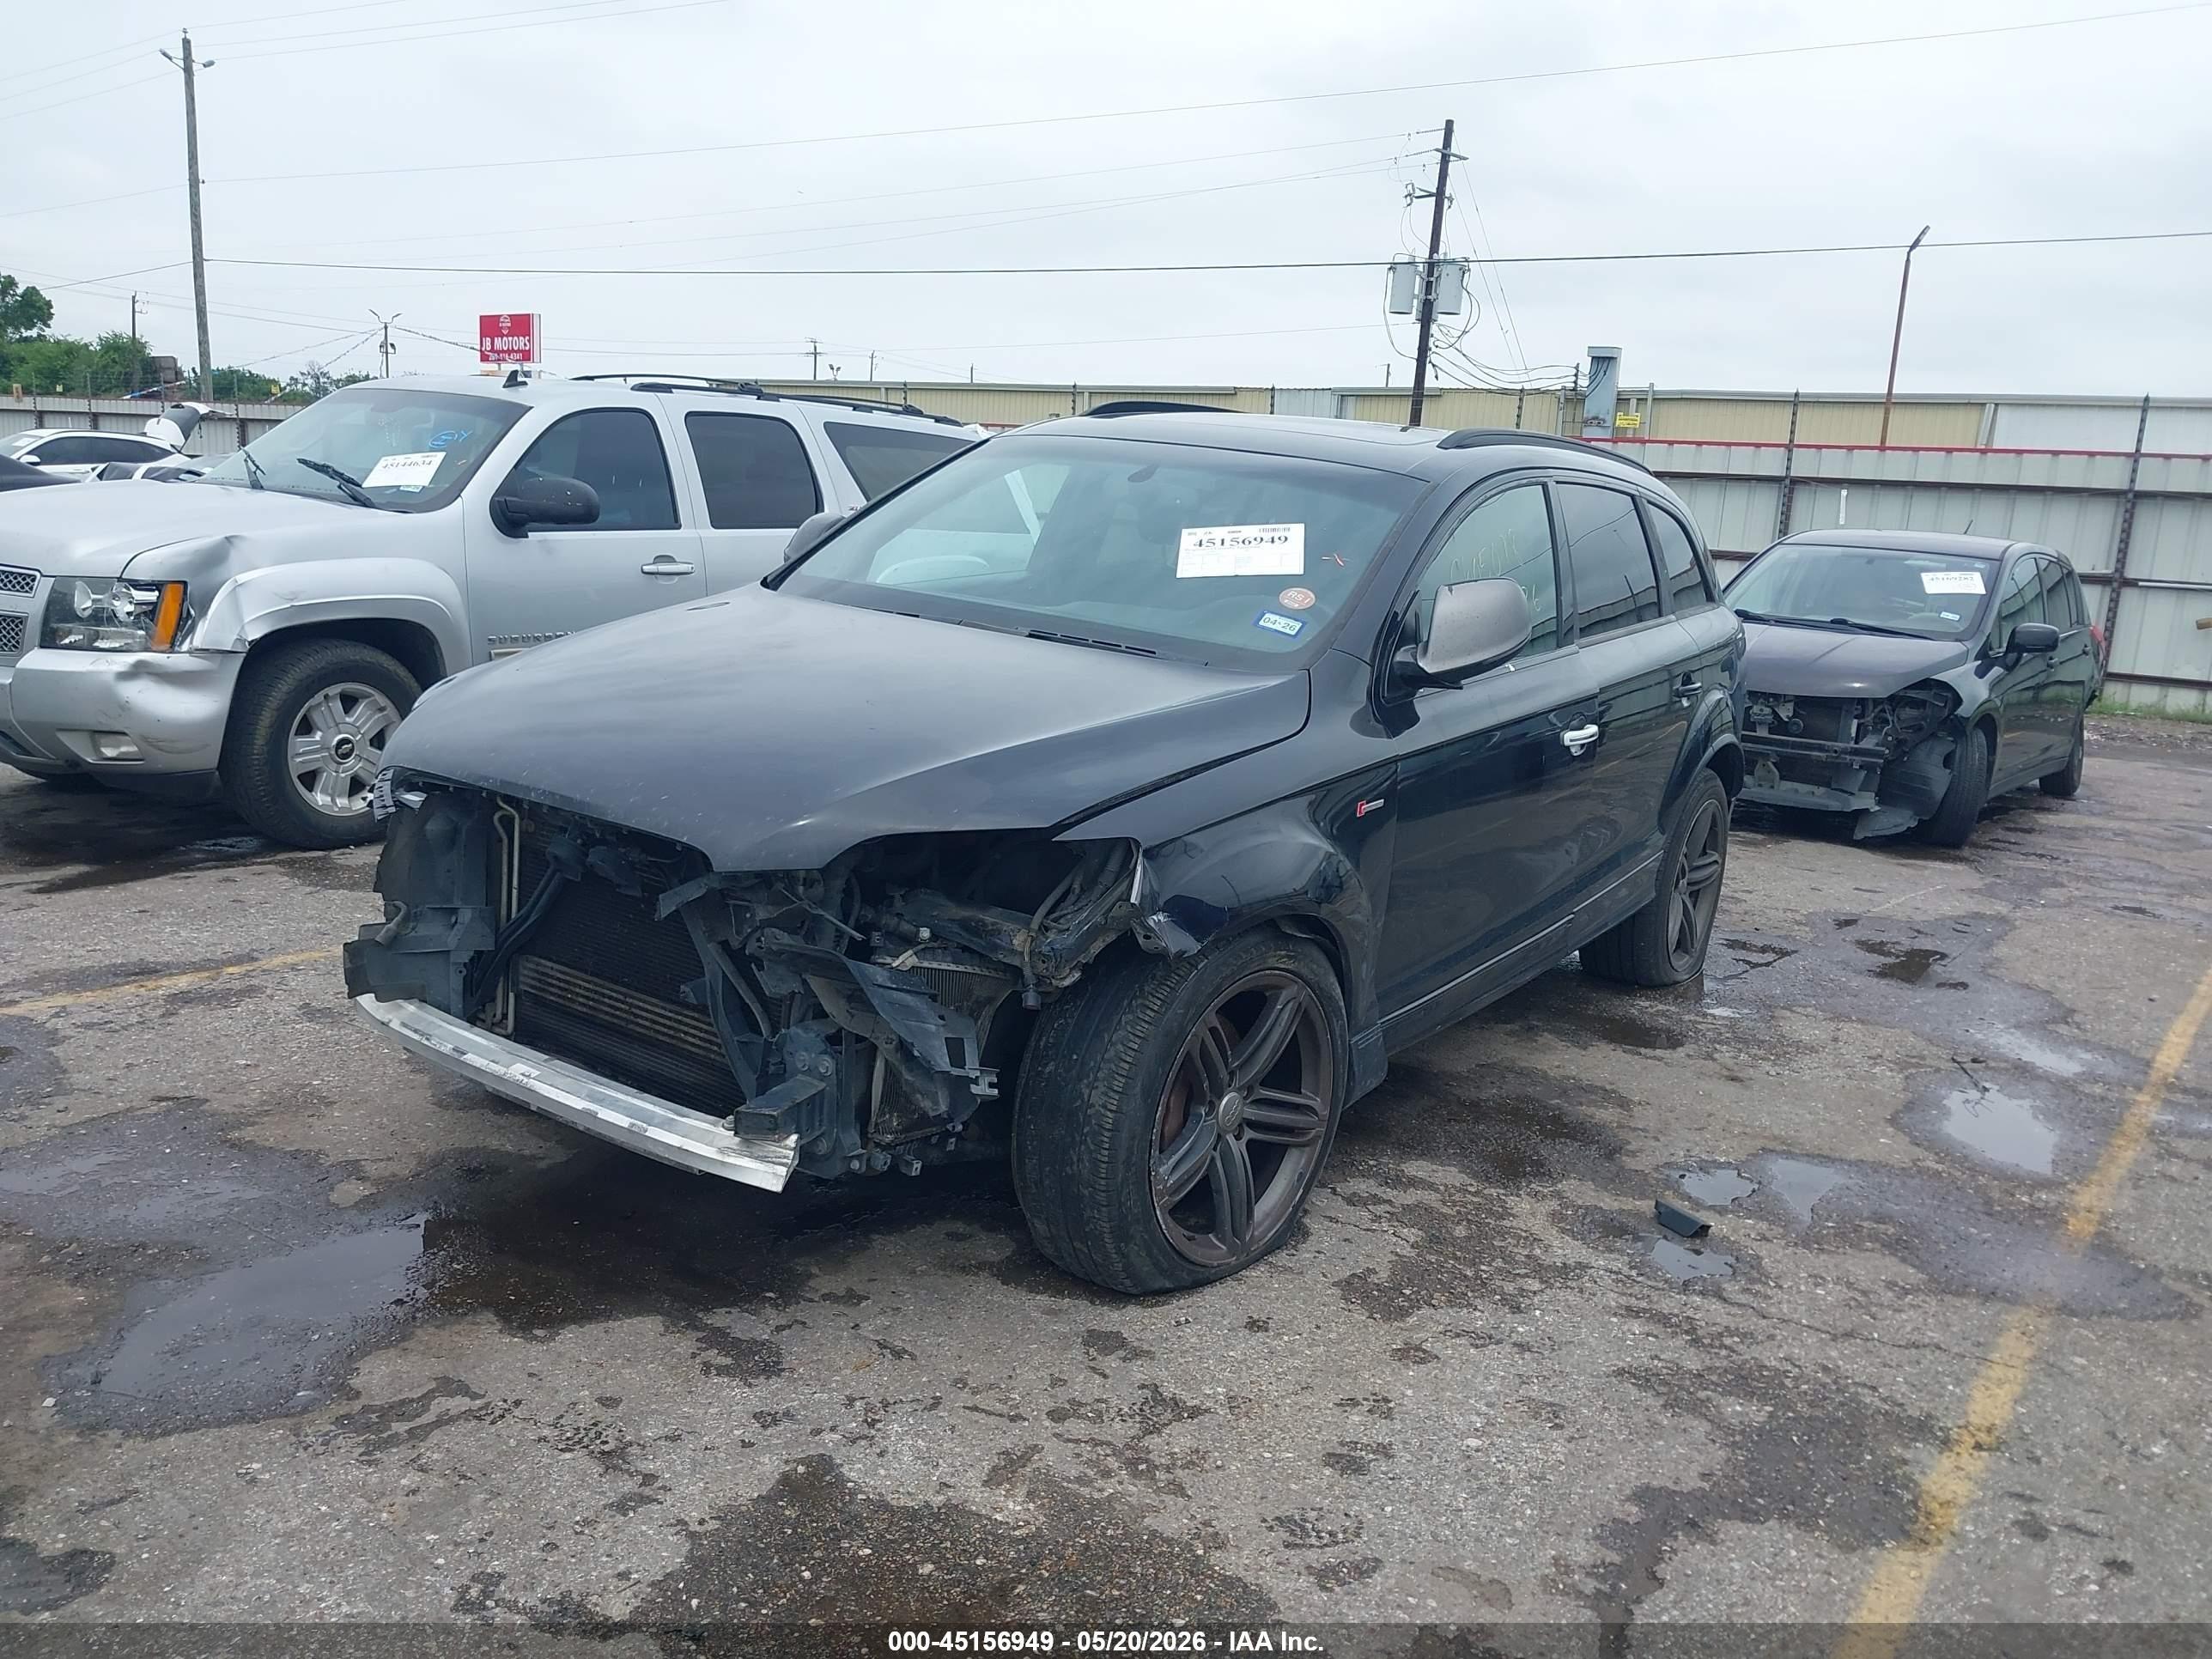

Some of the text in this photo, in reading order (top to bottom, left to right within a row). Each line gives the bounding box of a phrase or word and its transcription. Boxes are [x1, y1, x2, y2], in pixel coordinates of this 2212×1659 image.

[482, 336, 530, 351] JB MOTORS
[1193, 534, 1289, 549] 45156949
